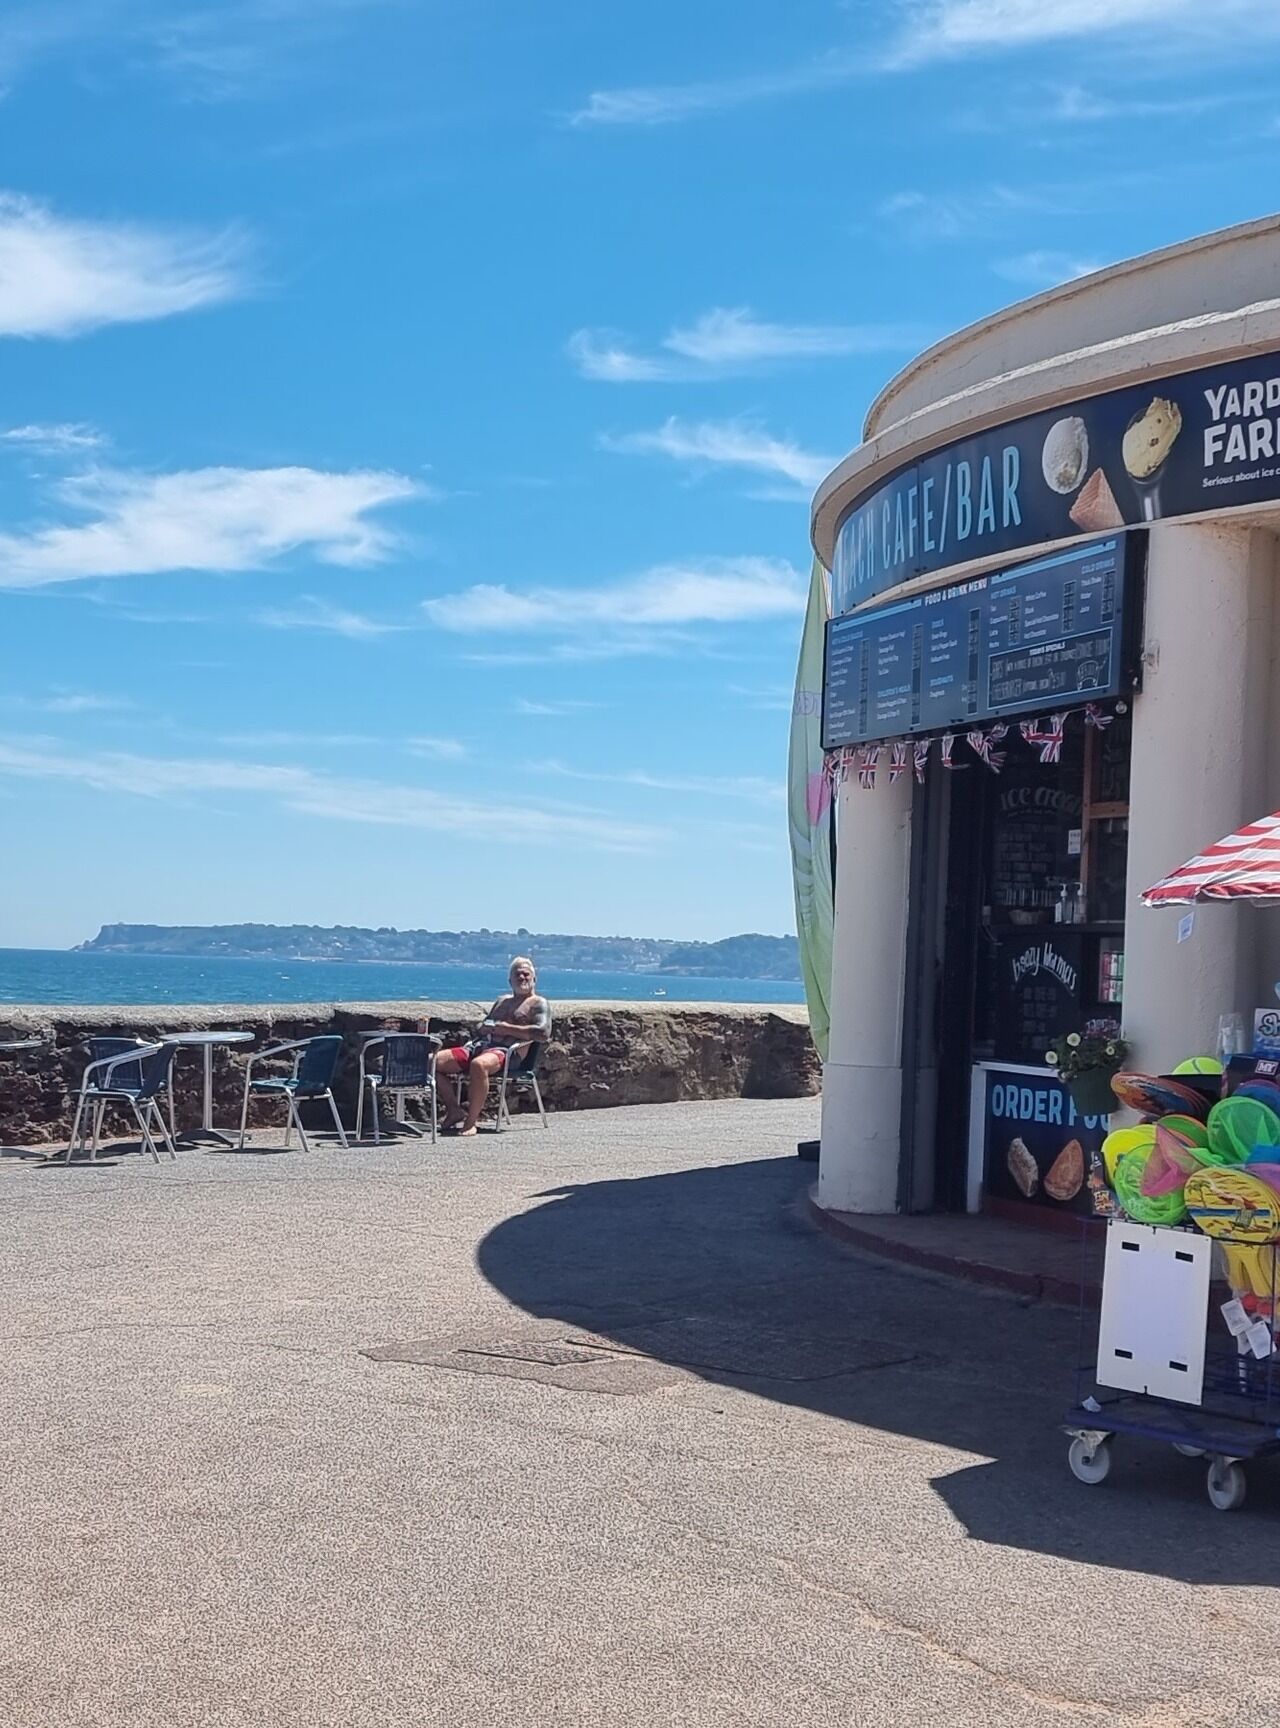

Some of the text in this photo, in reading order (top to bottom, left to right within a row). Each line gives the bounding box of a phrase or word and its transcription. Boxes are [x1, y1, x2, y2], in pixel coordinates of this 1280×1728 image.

[1202, 475, 1234, 488] Serious
[1235, 470, 1260, 482] about
[1261, 467, 1274, 478] ice
[882, 446, 1021, 570] CAFE/BAR
[992, 1085, 1063, 1125] ORDER
